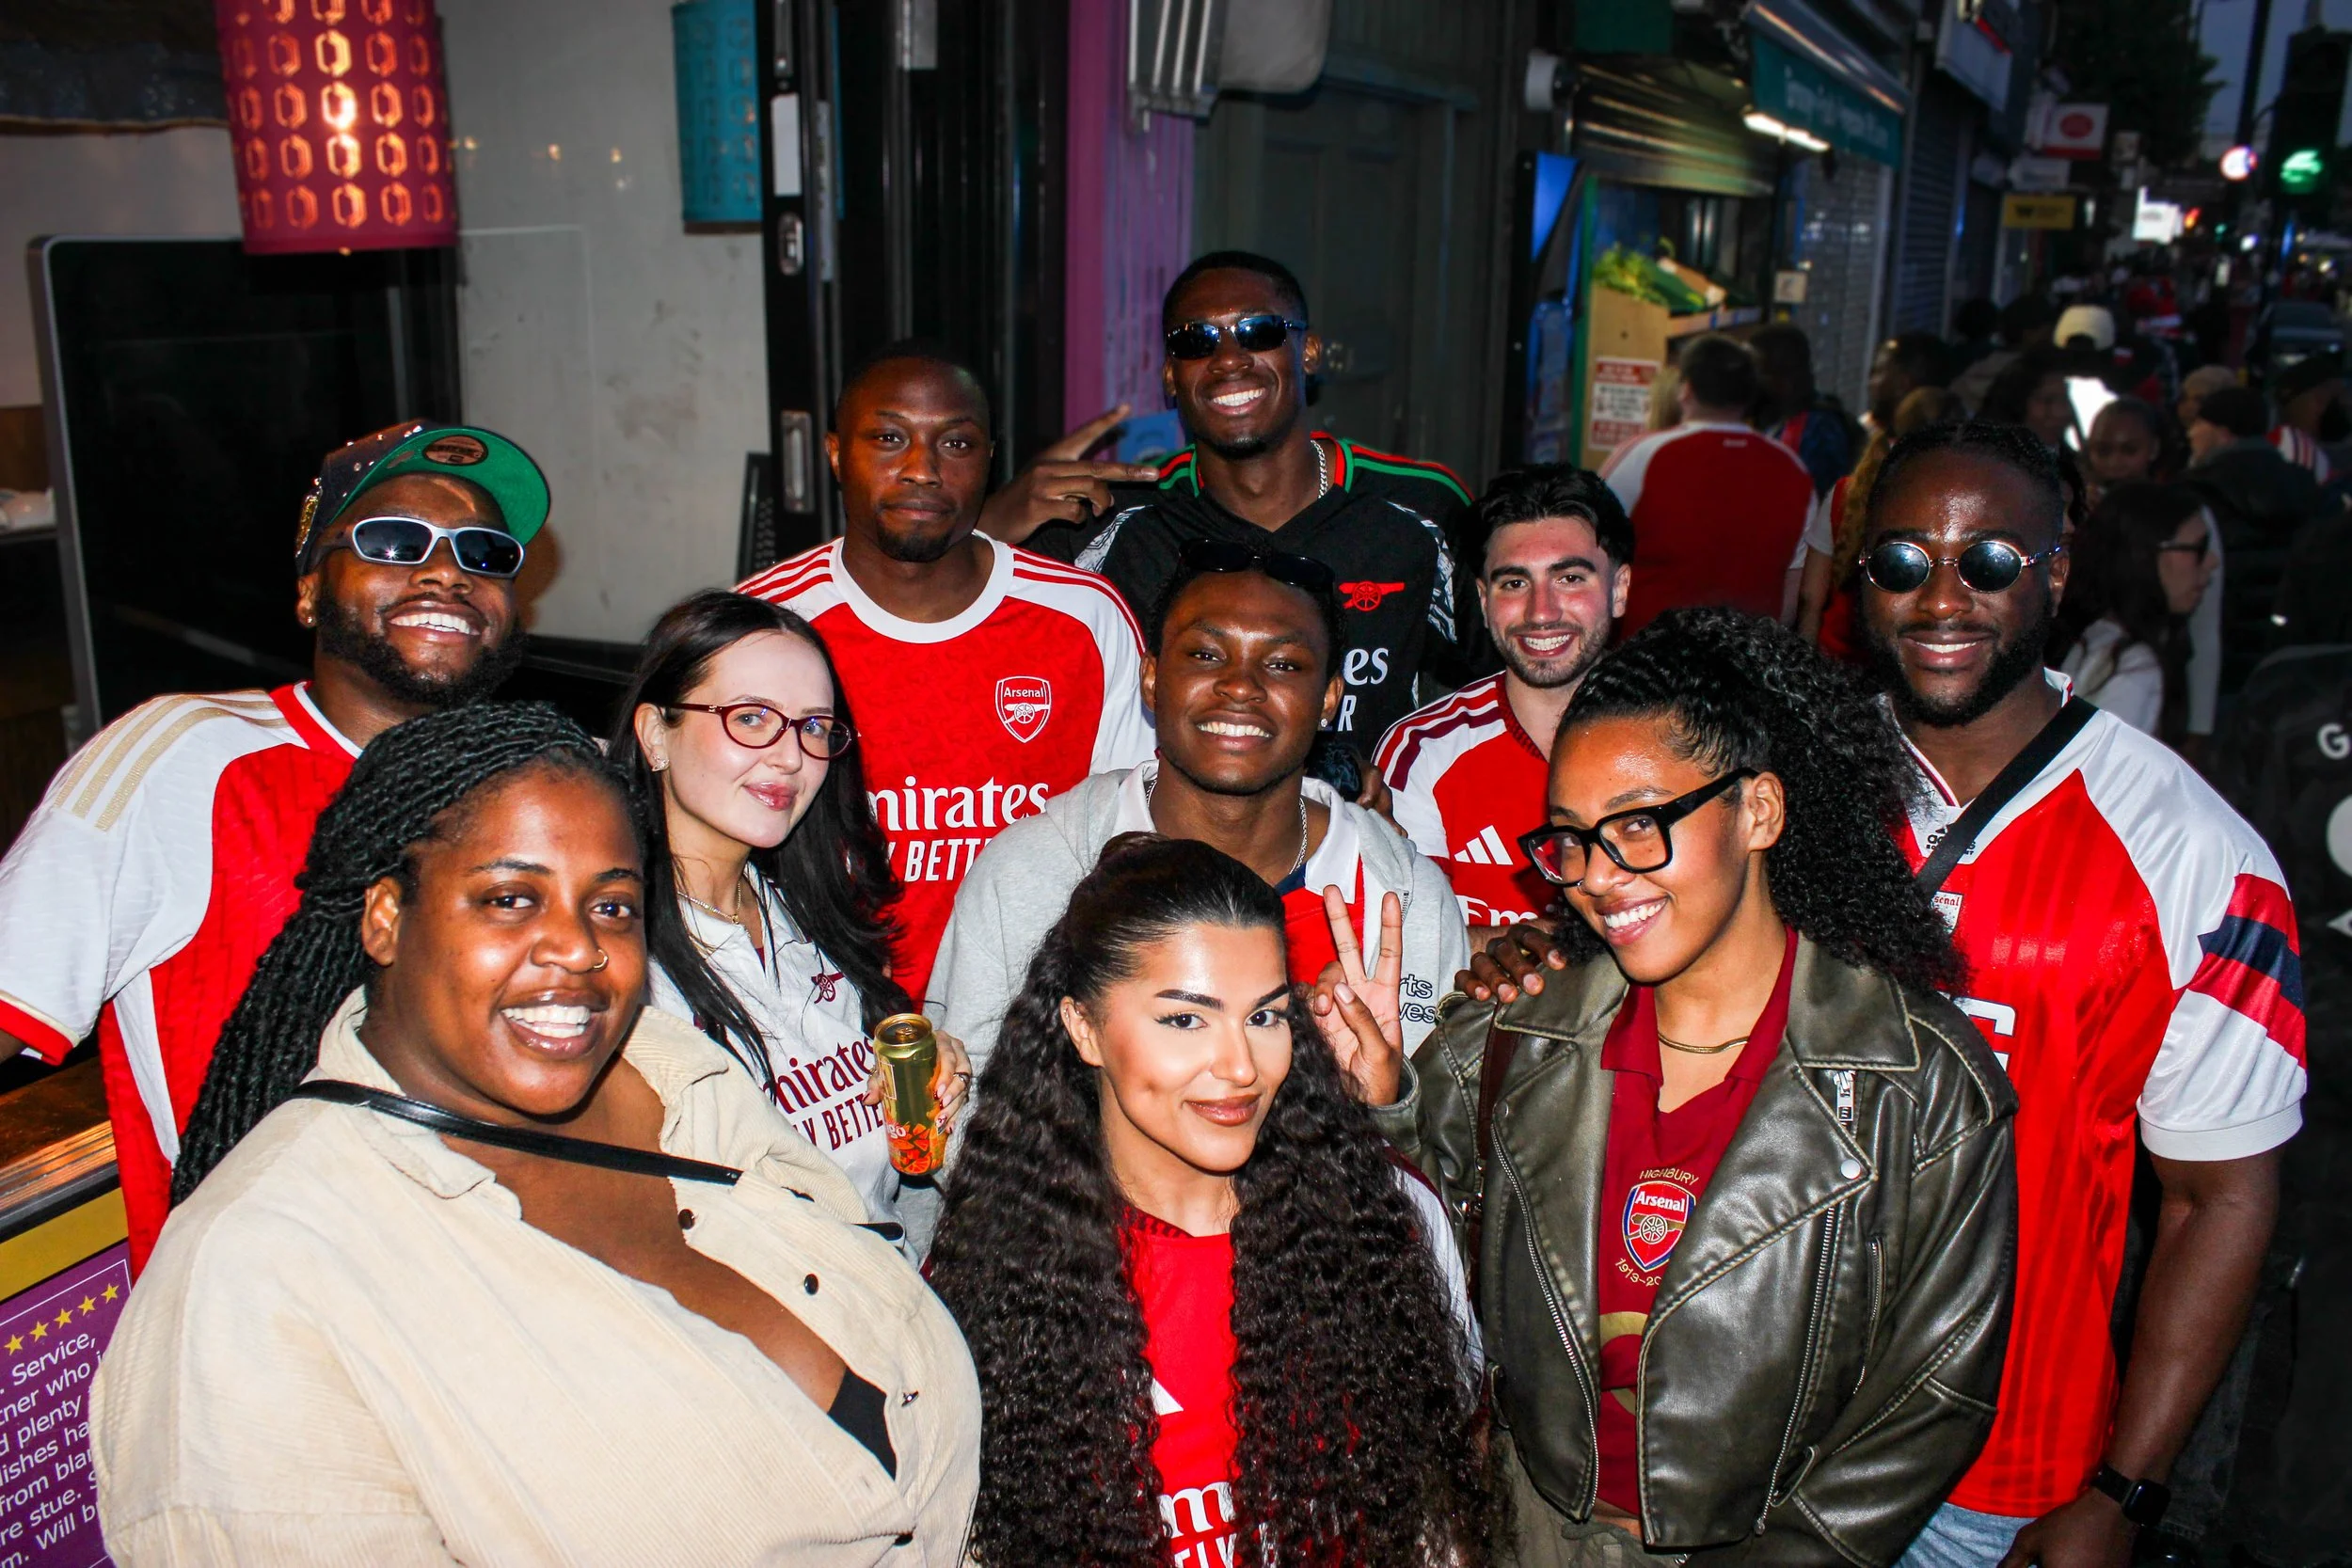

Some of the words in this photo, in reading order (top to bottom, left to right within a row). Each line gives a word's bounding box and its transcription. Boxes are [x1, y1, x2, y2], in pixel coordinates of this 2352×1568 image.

[1343, 647, 1389, 686] es
[1003, 687, 1044, 698] Arsenal
[1337, 694, 1357, 732] R
[904, 838, 993, 883] BETT
[1640, 1167, 1700, 1186] HIGHBURY
[1635, 1191, 1685, 1212] Arsenal
[11, 1333, 96, 1386] Service,
[45, 1362, 91, 1397] who
[17, 1395, 82, 1449] plenty
[0, 1439, 58, 1486] ishes
[29, 1488, 82, 1527] stue.
[35, 1512, 76, 1550] Will
